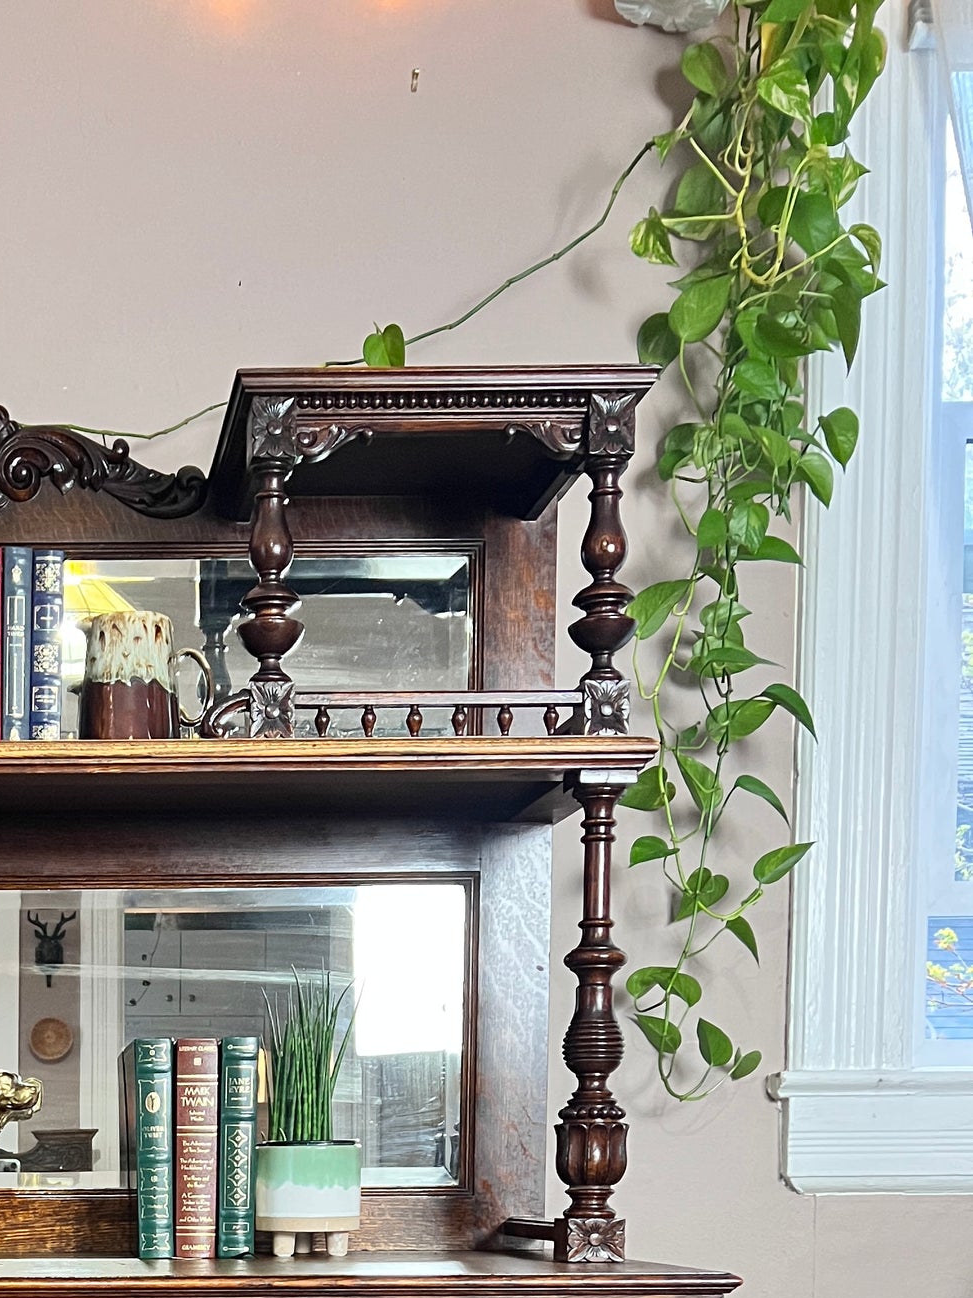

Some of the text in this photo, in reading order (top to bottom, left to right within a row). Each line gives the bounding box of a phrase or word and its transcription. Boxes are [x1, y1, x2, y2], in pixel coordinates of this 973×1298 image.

[229, 1077, 251, 1086] JANE
[184, 1087, 211, 1096] MARK
[229, 1086, 251, 1094] EYRE
[180, 1097, 215, 1107] TWAIN
